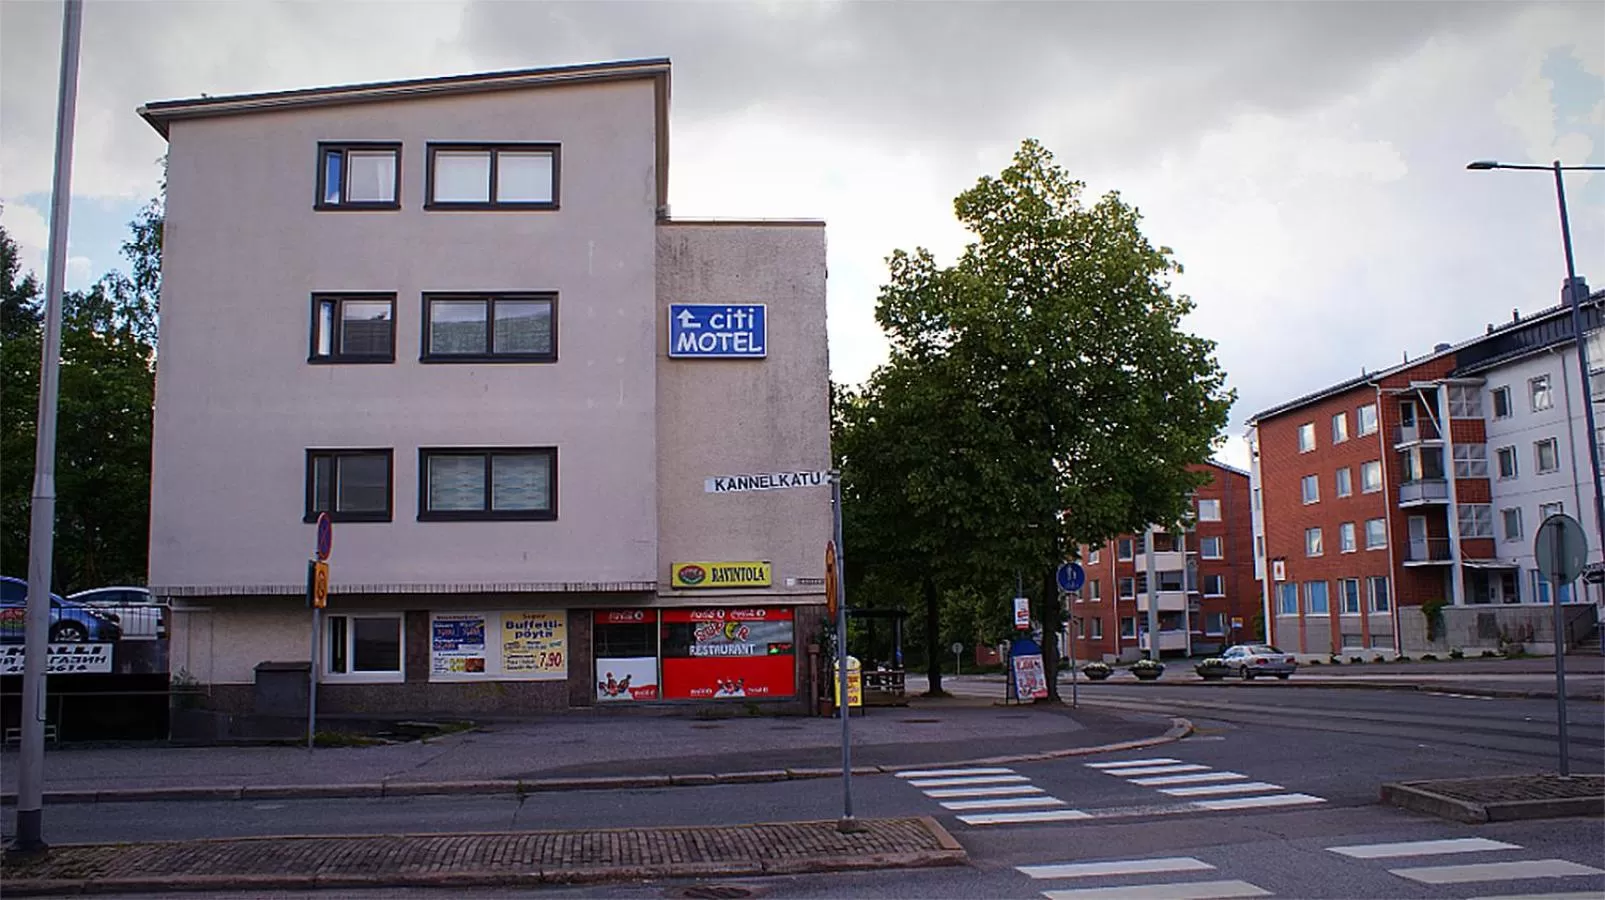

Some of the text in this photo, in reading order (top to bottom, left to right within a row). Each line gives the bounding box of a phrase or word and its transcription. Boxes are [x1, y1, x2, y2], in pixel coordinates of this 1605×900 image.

[709, 308, 754, 329] citi
[677, 332, 762, 352] MOTEL
[715, 472, 821, 491] KANNELKATU
[711, 567, 765, 582] RAVINTOLA
[689, 643, 756, 656] RESTAURANT
